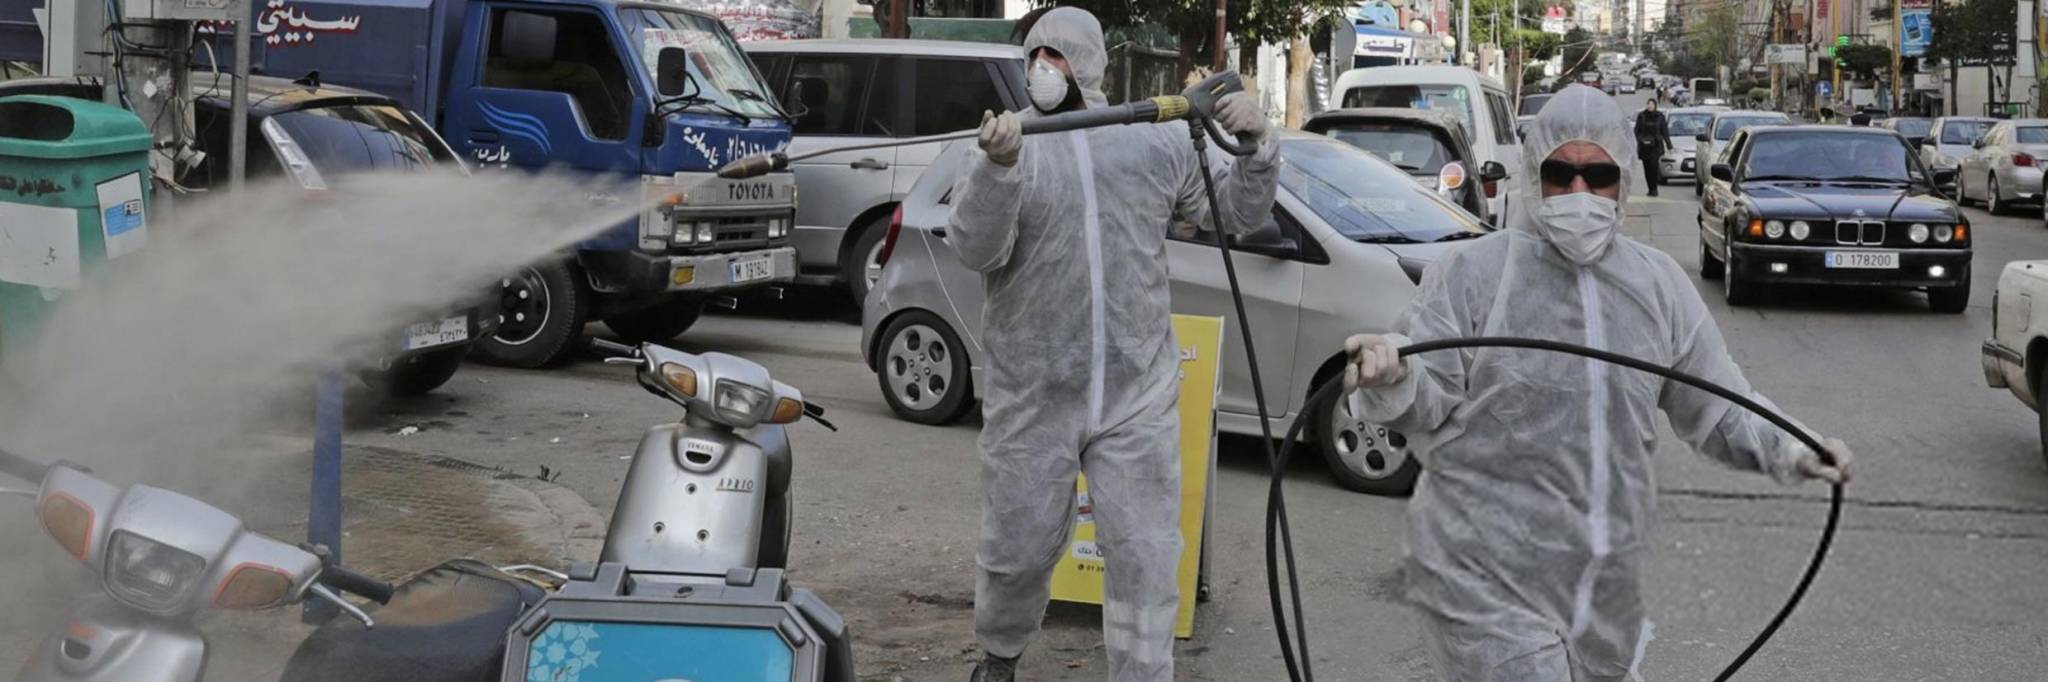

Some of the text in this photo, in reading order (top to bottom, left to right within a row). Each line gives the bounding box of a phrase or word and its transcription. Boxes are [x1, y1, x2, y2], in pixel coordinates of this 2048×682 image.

[257, 0, 361, 45] سبيتي
[728, 183, 774, 200] TOYOTA
[1851, 254, 1892, 266] 178200
